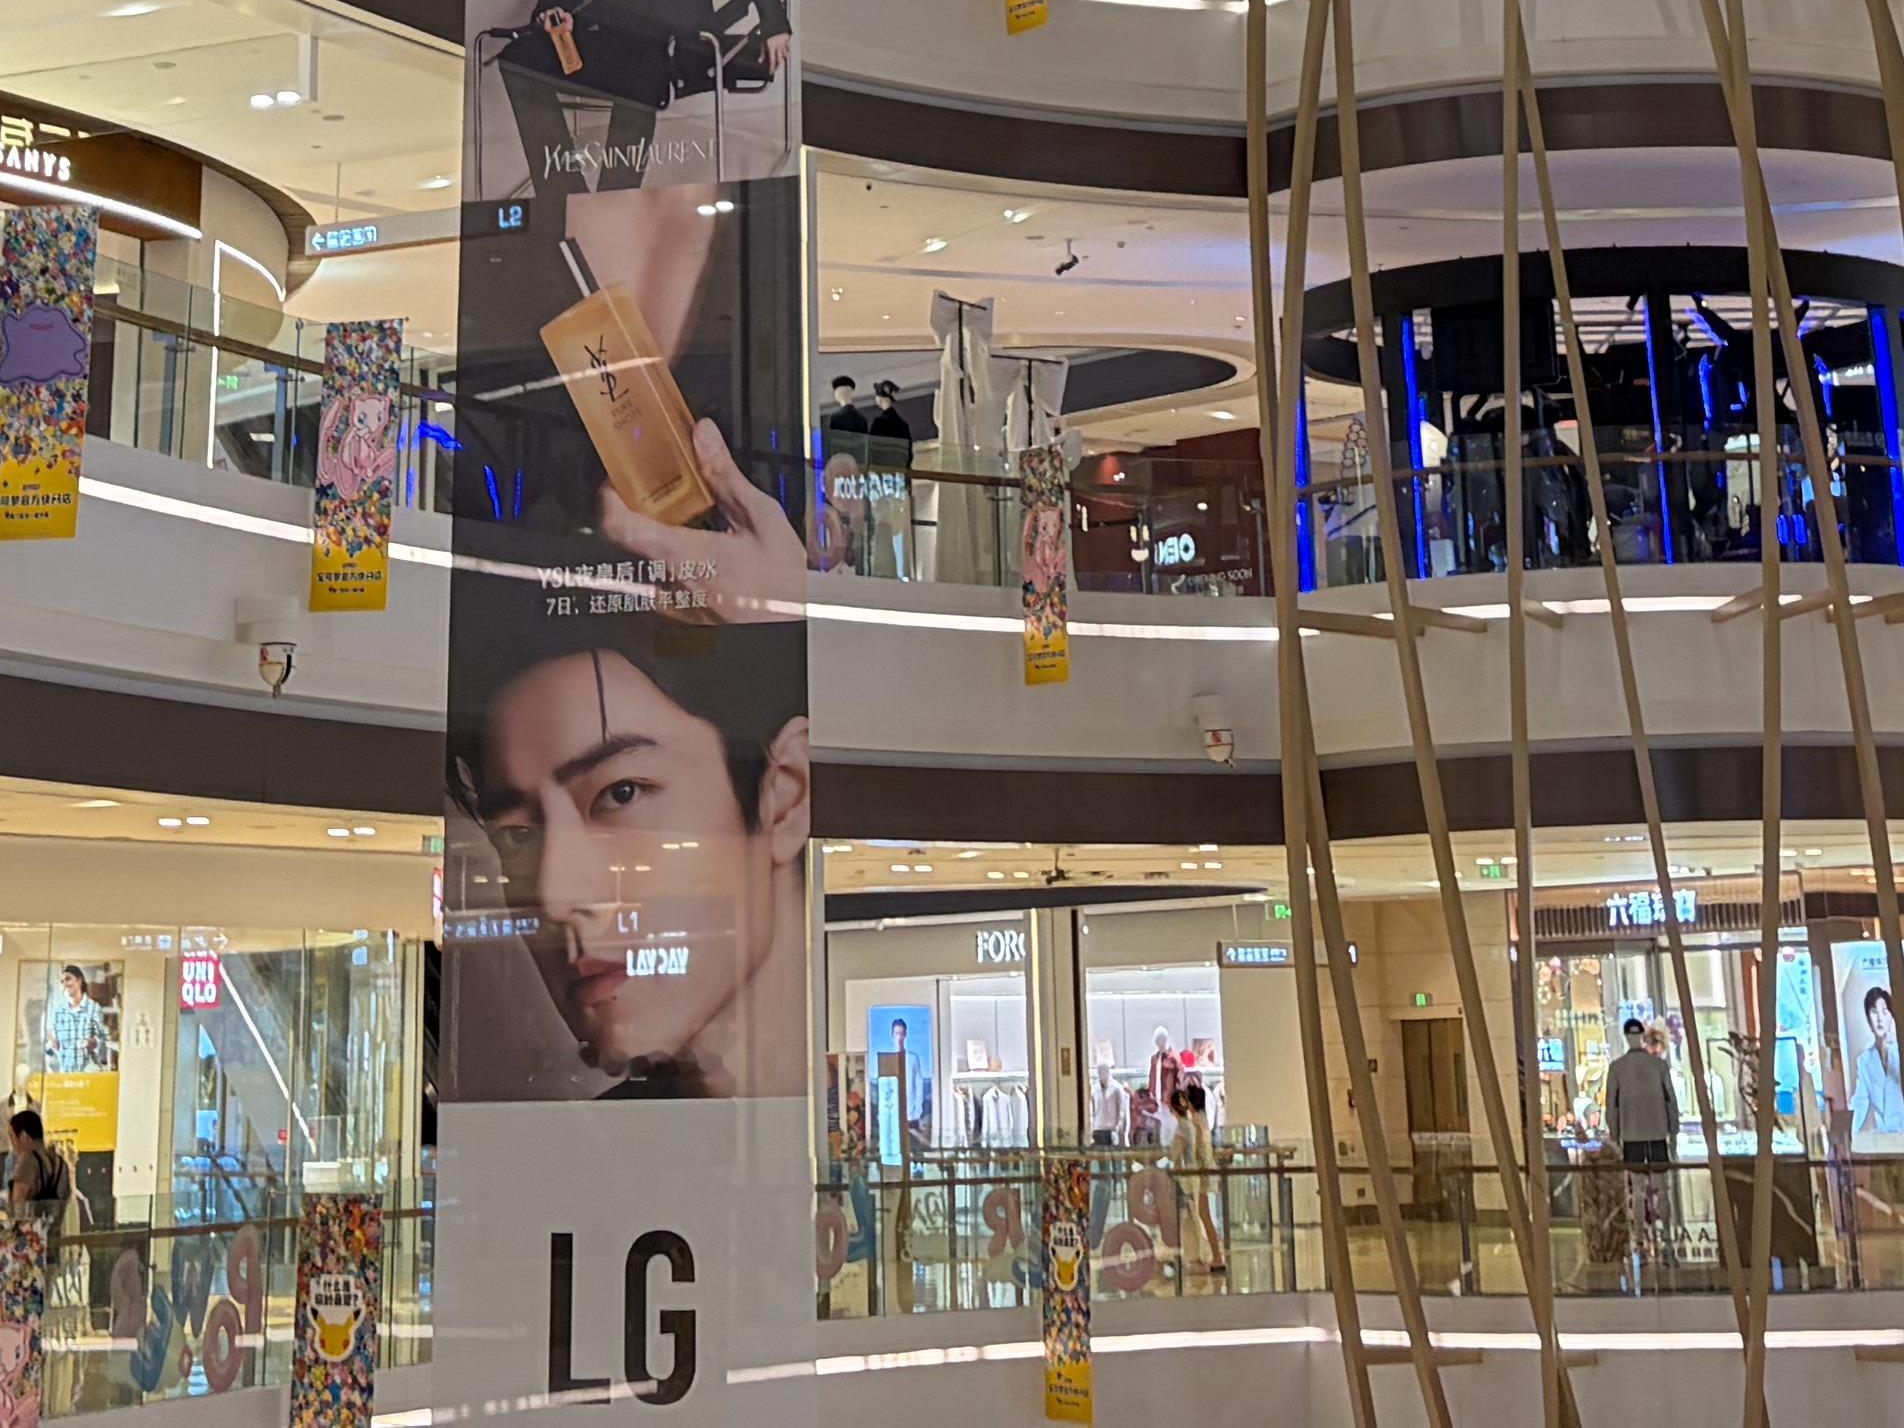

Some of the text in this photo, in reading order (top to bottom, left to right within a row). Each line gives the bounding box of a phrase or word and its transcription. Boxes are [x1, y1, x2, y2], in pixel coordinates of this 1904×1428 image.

[498, 205, 521, 229] L2
[617, 912, 638, 933] L1
[182, 960, 215, 980] UNI
[181, 982, 217, 1006] QLO
[547, 1229, 697, 1407] LG
